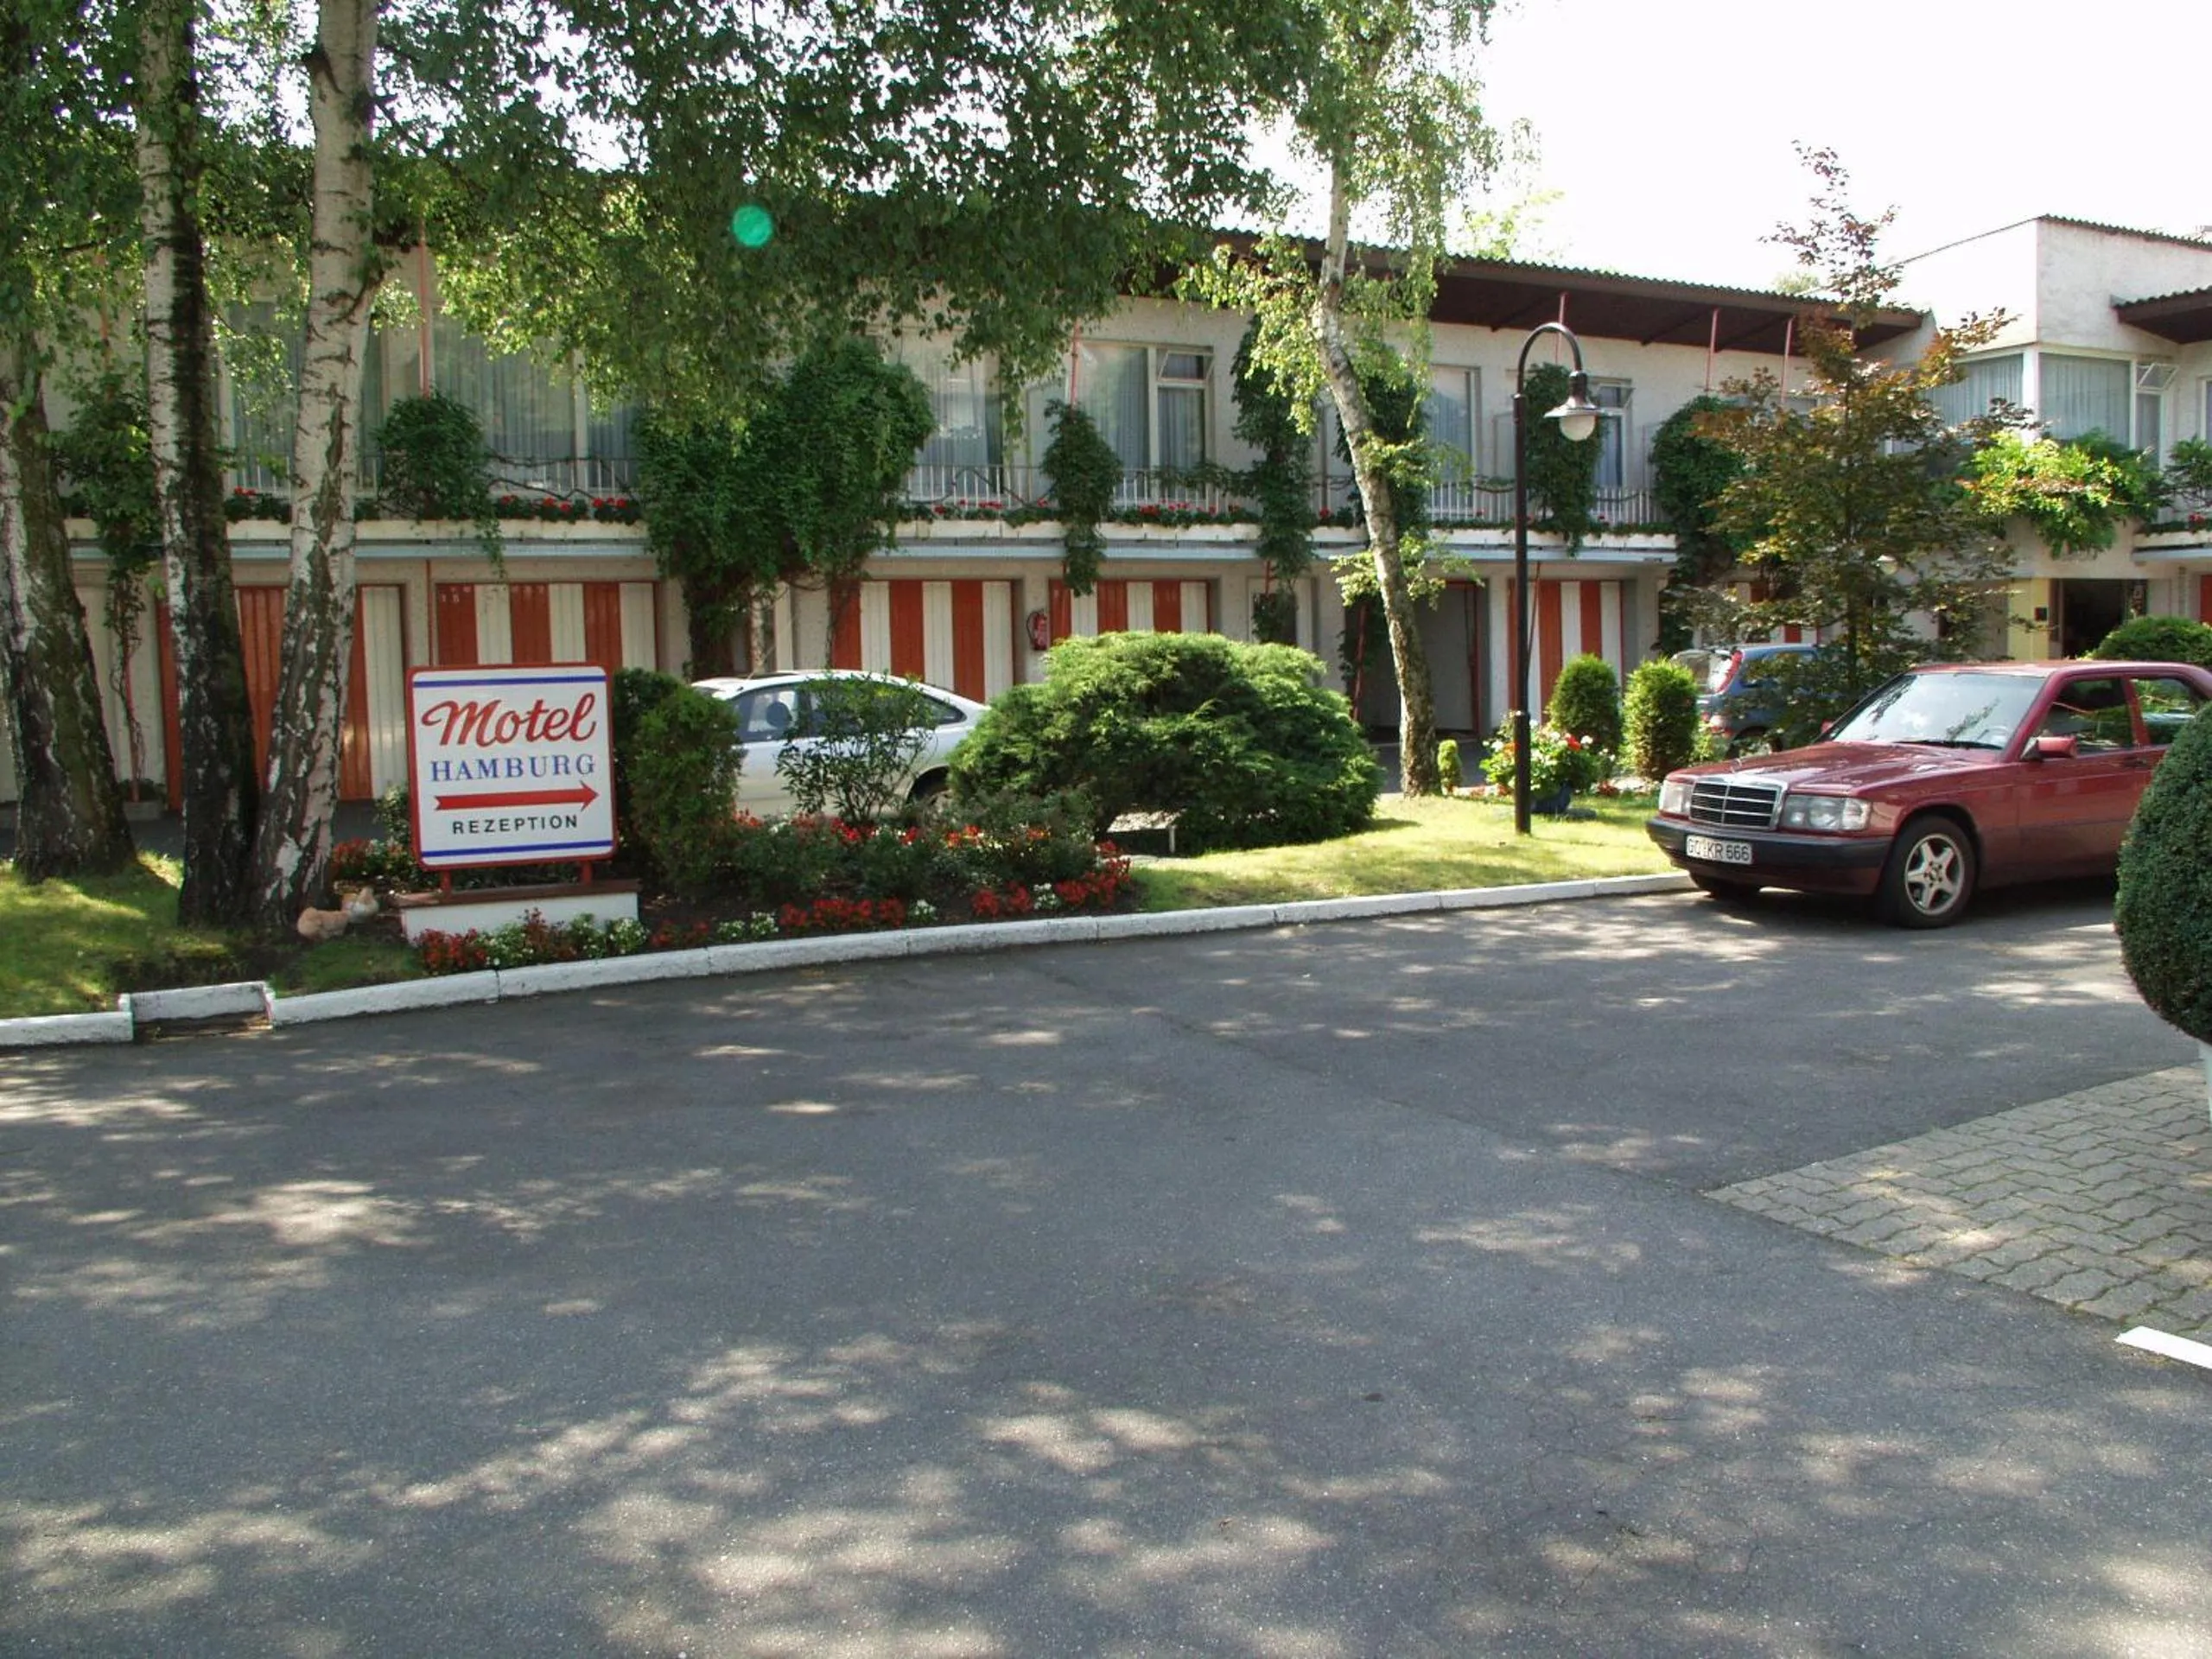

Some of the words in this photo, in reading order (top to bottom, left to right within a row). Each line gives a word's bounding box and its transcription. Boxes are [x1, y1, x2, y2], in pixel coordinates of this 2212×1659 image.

[421, 692, 596, 748] Motel
[430, 753, 595, 782] HAMBURG
[453, 814, 578, 835] REZEPTION
